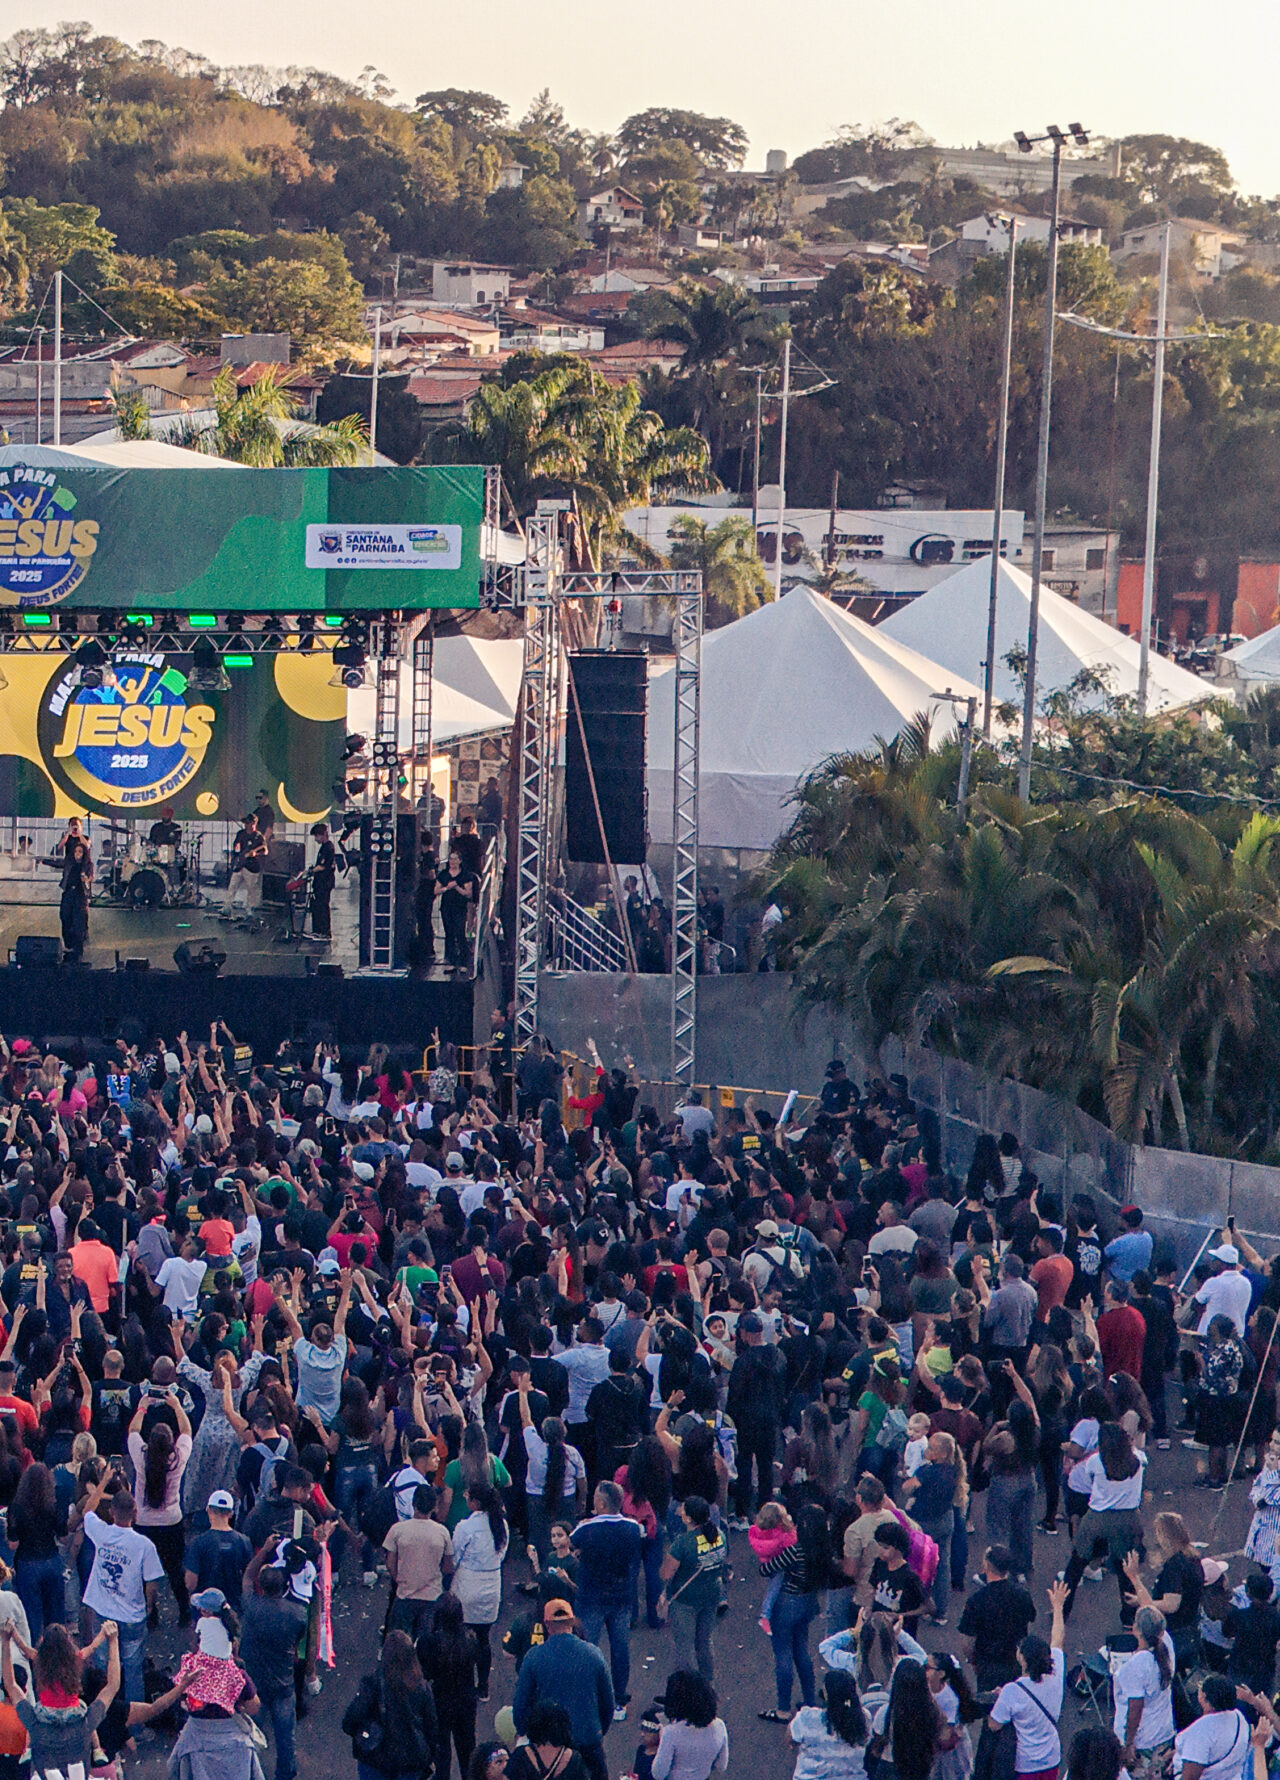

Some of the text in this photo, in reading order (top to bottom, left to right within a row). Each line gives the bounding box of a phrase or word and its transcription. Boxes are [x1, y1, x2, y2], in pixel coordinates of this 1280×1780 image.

[14, 468, 57, 488] PARA
[346, 535, 394, 544] SANTANA
[9, 570, 43, 583] 2025
[19, 592, 51, 607] DEUS
[53, 704, 216, 758] JESUS
[110, 755, 150, 769] 2025
[120, 756, 197, 803] DEUS FORTE!
